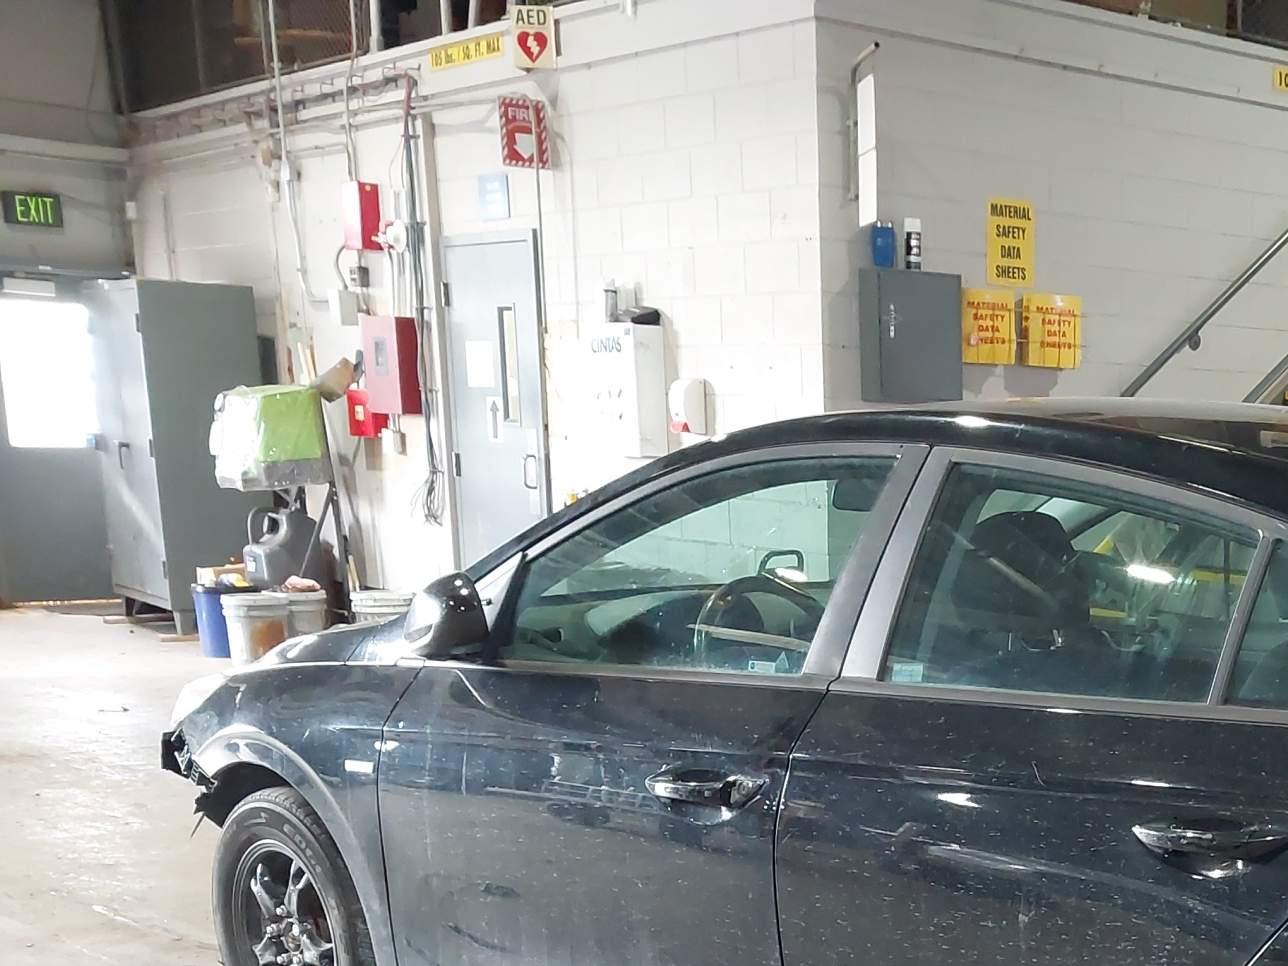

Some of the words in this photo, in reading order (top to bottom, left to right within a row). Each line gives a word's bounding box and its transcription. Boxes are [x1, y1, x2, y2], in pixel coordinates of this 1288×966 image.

[516, 9, 546, 25] AED
[431, 51, 442, 67] 105
[462, 44, 473, 60] SQ.
[475, 41, 484, 58] FT.
[486, 36, 501, 53] MAX
[508, 107, 529, 120] FIR
[15, 195, 54, 224] EXIT
[990, 203, 1032, 221] MATERIAL
[996, 224, 1026, 240] SAFETY
[1001, 245, 1021, 260] DATA
[995, 265, 1026, 280] SHEETS
[966, 301, 1008, 311] MATERIAL
[973, 313, 1005, 322] SAFETY
[978, 325, 1000, 333] DATA
[1047, 329, 1067, 338] DATA
[968, 336, 1006, 345] HEETS
